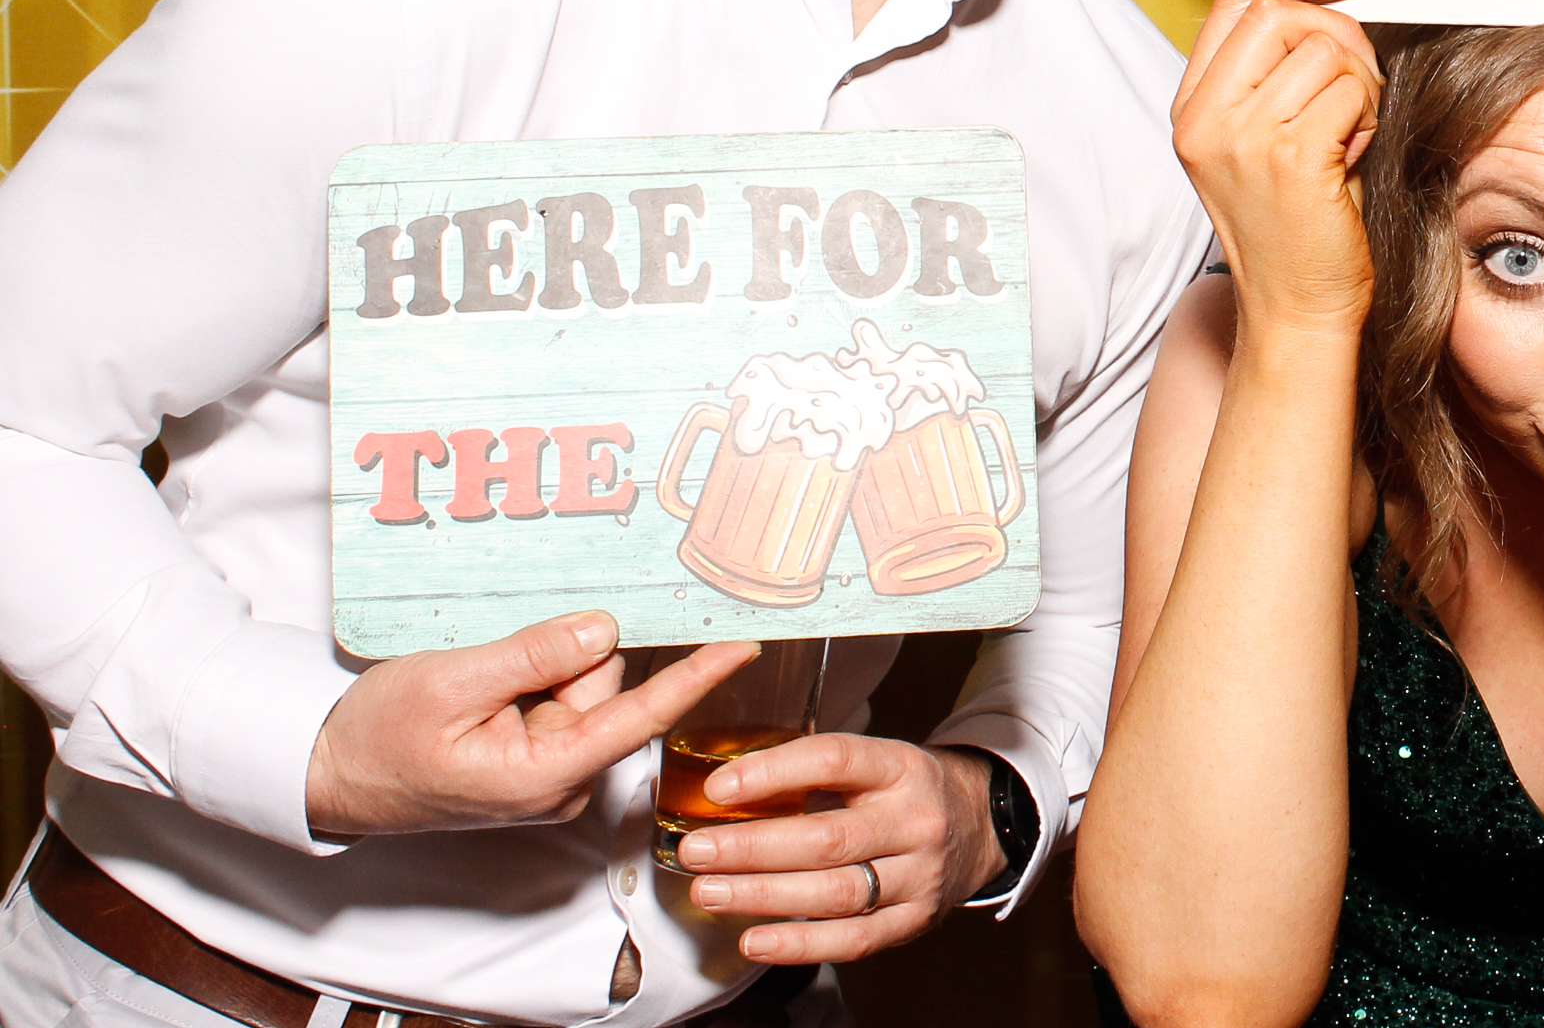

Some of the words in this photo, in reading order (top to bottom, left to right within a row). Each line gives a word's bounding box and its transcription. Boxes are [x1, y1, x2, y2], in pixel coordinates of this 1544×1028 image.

[356, 183, 713, 320] HERE
[742, 184, 1006, 303] FOR
[353, 422, 640, 526] THE
